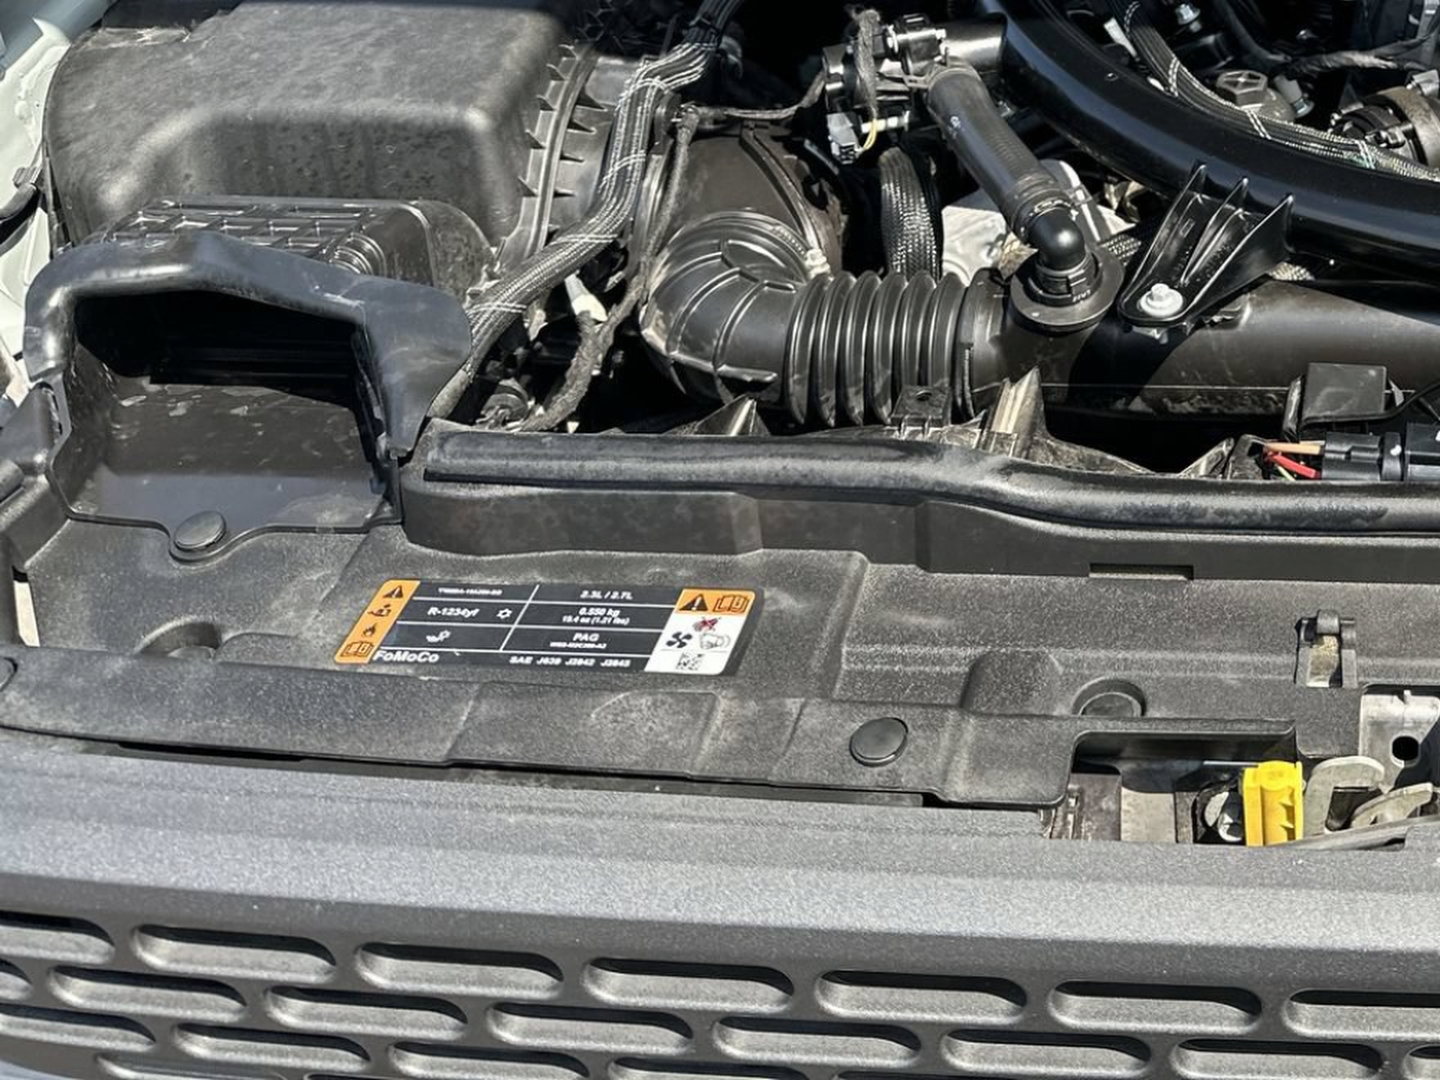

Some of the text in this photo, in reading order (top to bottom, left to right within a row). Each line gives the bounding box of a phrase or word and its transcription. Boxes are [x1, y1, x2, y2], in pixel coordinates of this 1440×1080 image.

[427, 606, 480, 618] R-1234yf
[607, 608, 621, 618] kg
[572, 632, 600, 642] PAG
[372, 650, 440, 663] FoMoCo
[509, 655, 533, 664] SAE
